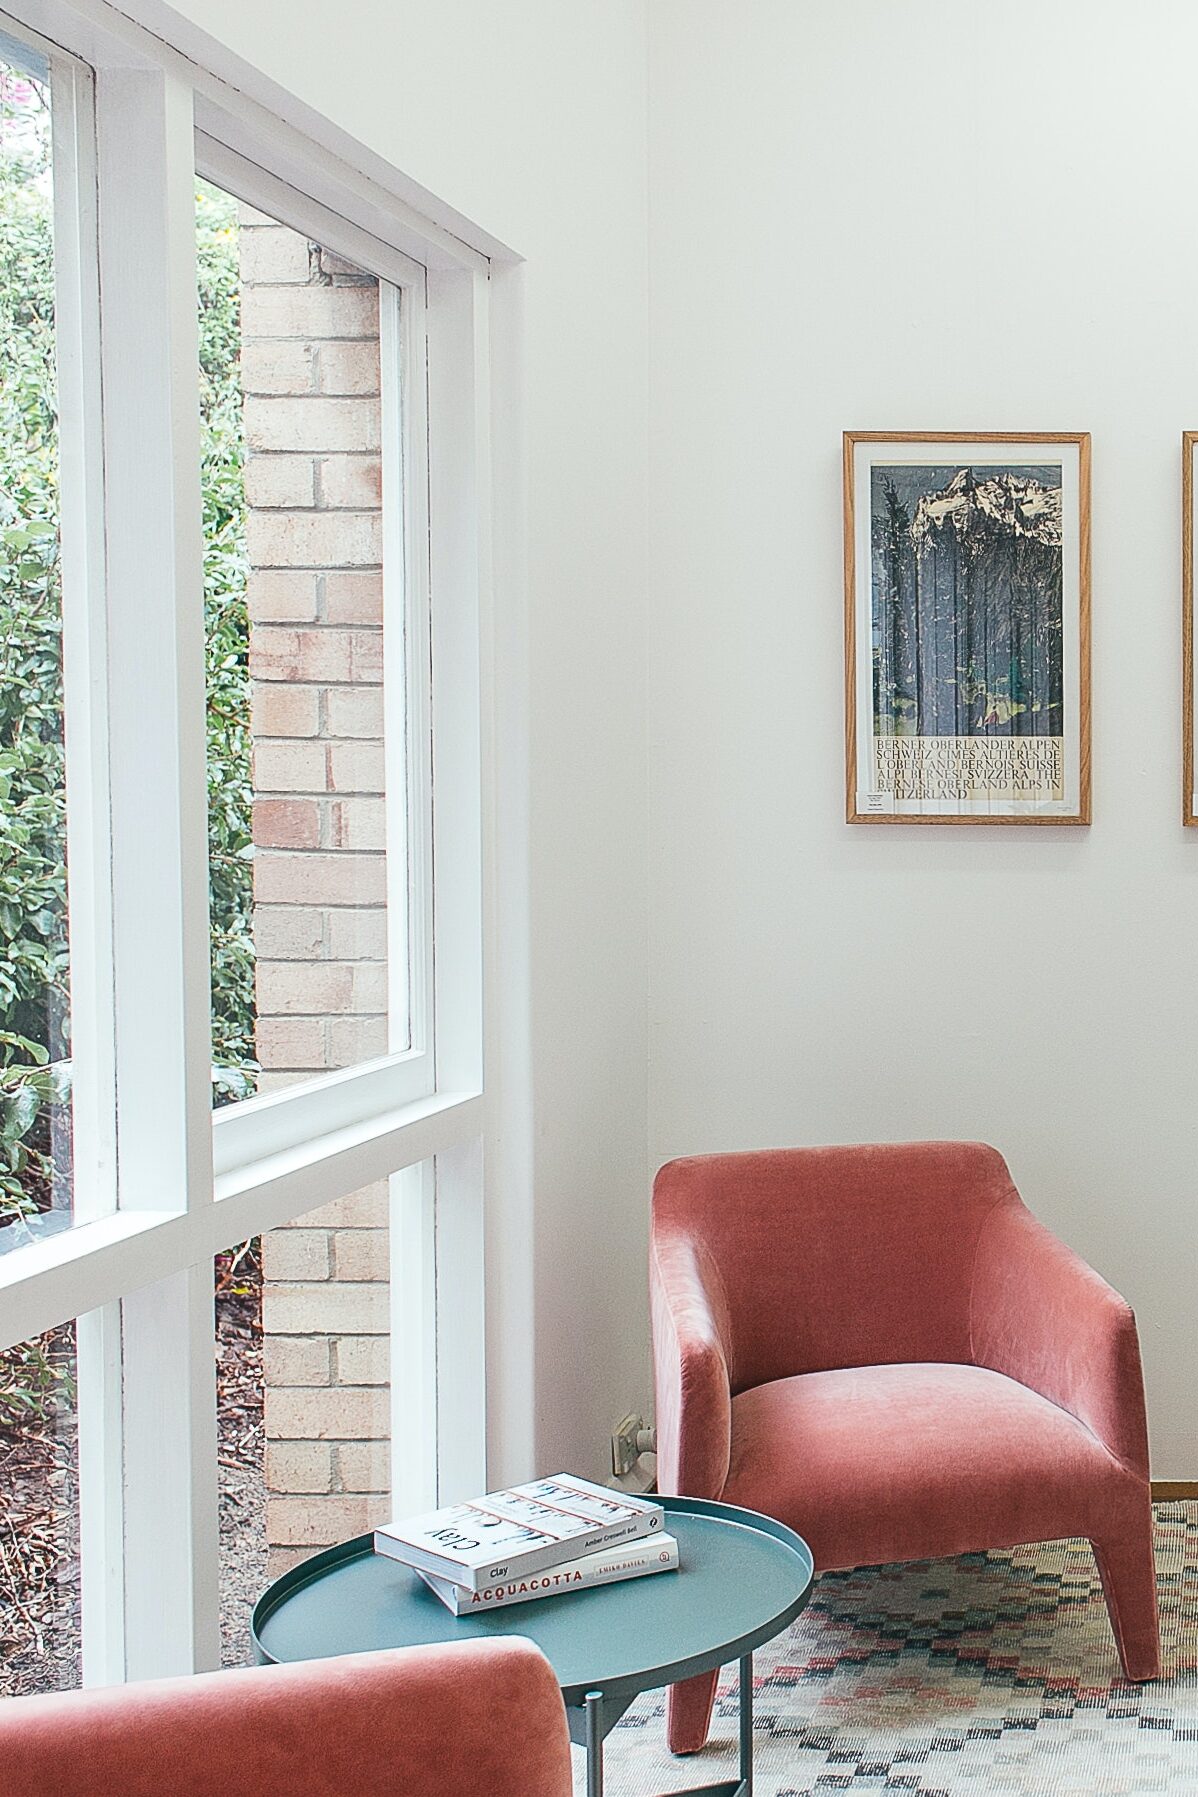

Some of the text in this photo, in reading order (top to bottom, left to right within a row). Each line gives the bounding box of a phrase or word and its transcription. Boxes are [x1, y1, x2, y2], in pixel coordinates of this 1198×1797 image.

[877, 739, 925, 750] BERNER
[1019, 739, 1060, 750] ALPEN
[876, 749, 932, 760] SCHWEIZ
[938, 749, 976, 760] CIMES
[1044, 749, 1061, 760] DE
[961, 759, 1015, 770] BERNOIS
[1019, 759, 1061, 770] SUISSE
[878, 769, 1062, 780] ALPI BERNESI SVIZZERA THE
[877, 779, 1060, 790] BERNESE OBERLAND ALPS IN
[877, 789, 968, 800] ITZERLAND
[424, 1527, 481, 1550] Clay
[584, 1525, 637, 1548] Amber Creswell Bell
[490, 1566, 509, 1579] Clay
[599, 1564, 620, 1574] EMIKO
[472, 1570, 583, 1603] ACQUACOTTA
